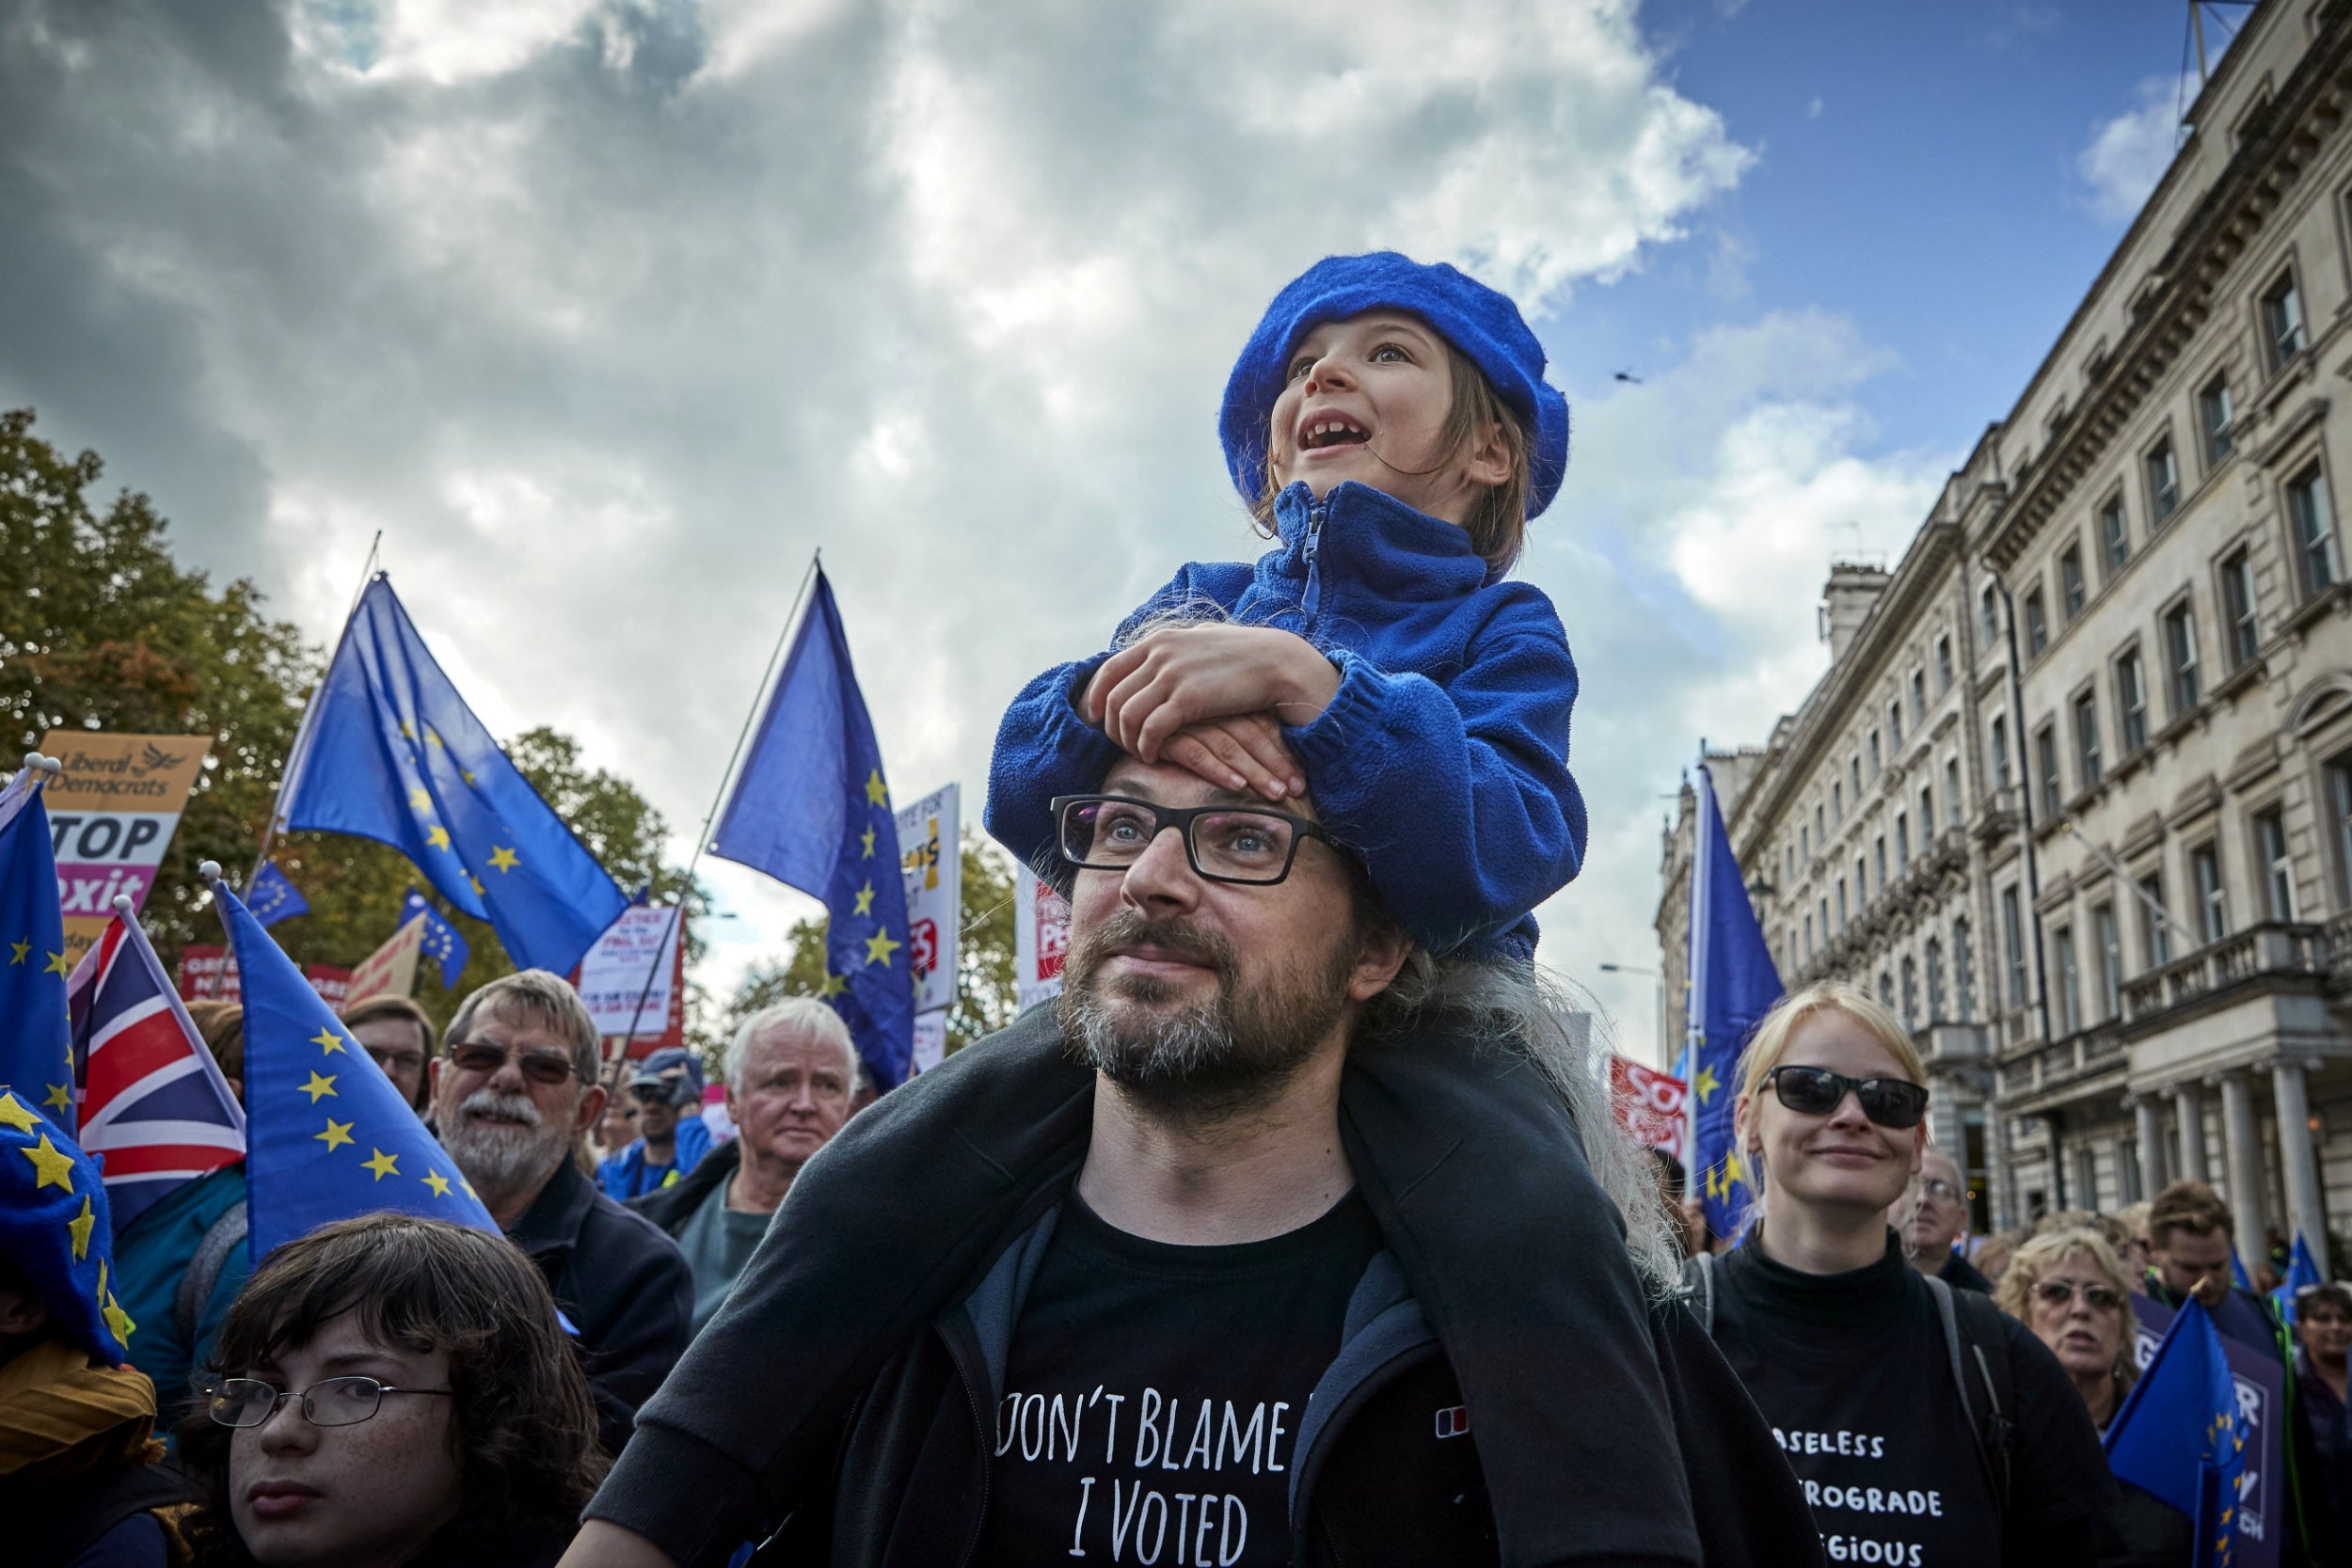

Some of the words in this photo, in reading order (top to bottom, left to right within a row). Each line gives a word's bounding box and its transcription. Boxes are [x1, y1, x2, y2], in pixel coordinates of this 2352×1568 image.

[60, 752, 133, 774] Liberal
[48, 772, 169, 797] Democrats
[994, 1385, 1124, 1464] DON'T
[1135, 1387, 1290, 1475] BLAME
[1069, 1476, 1096, 1558] I
[1112, 1478, 1248, 1568] VOTED
[1819, 1532, 1924, 1568] GiOUS
